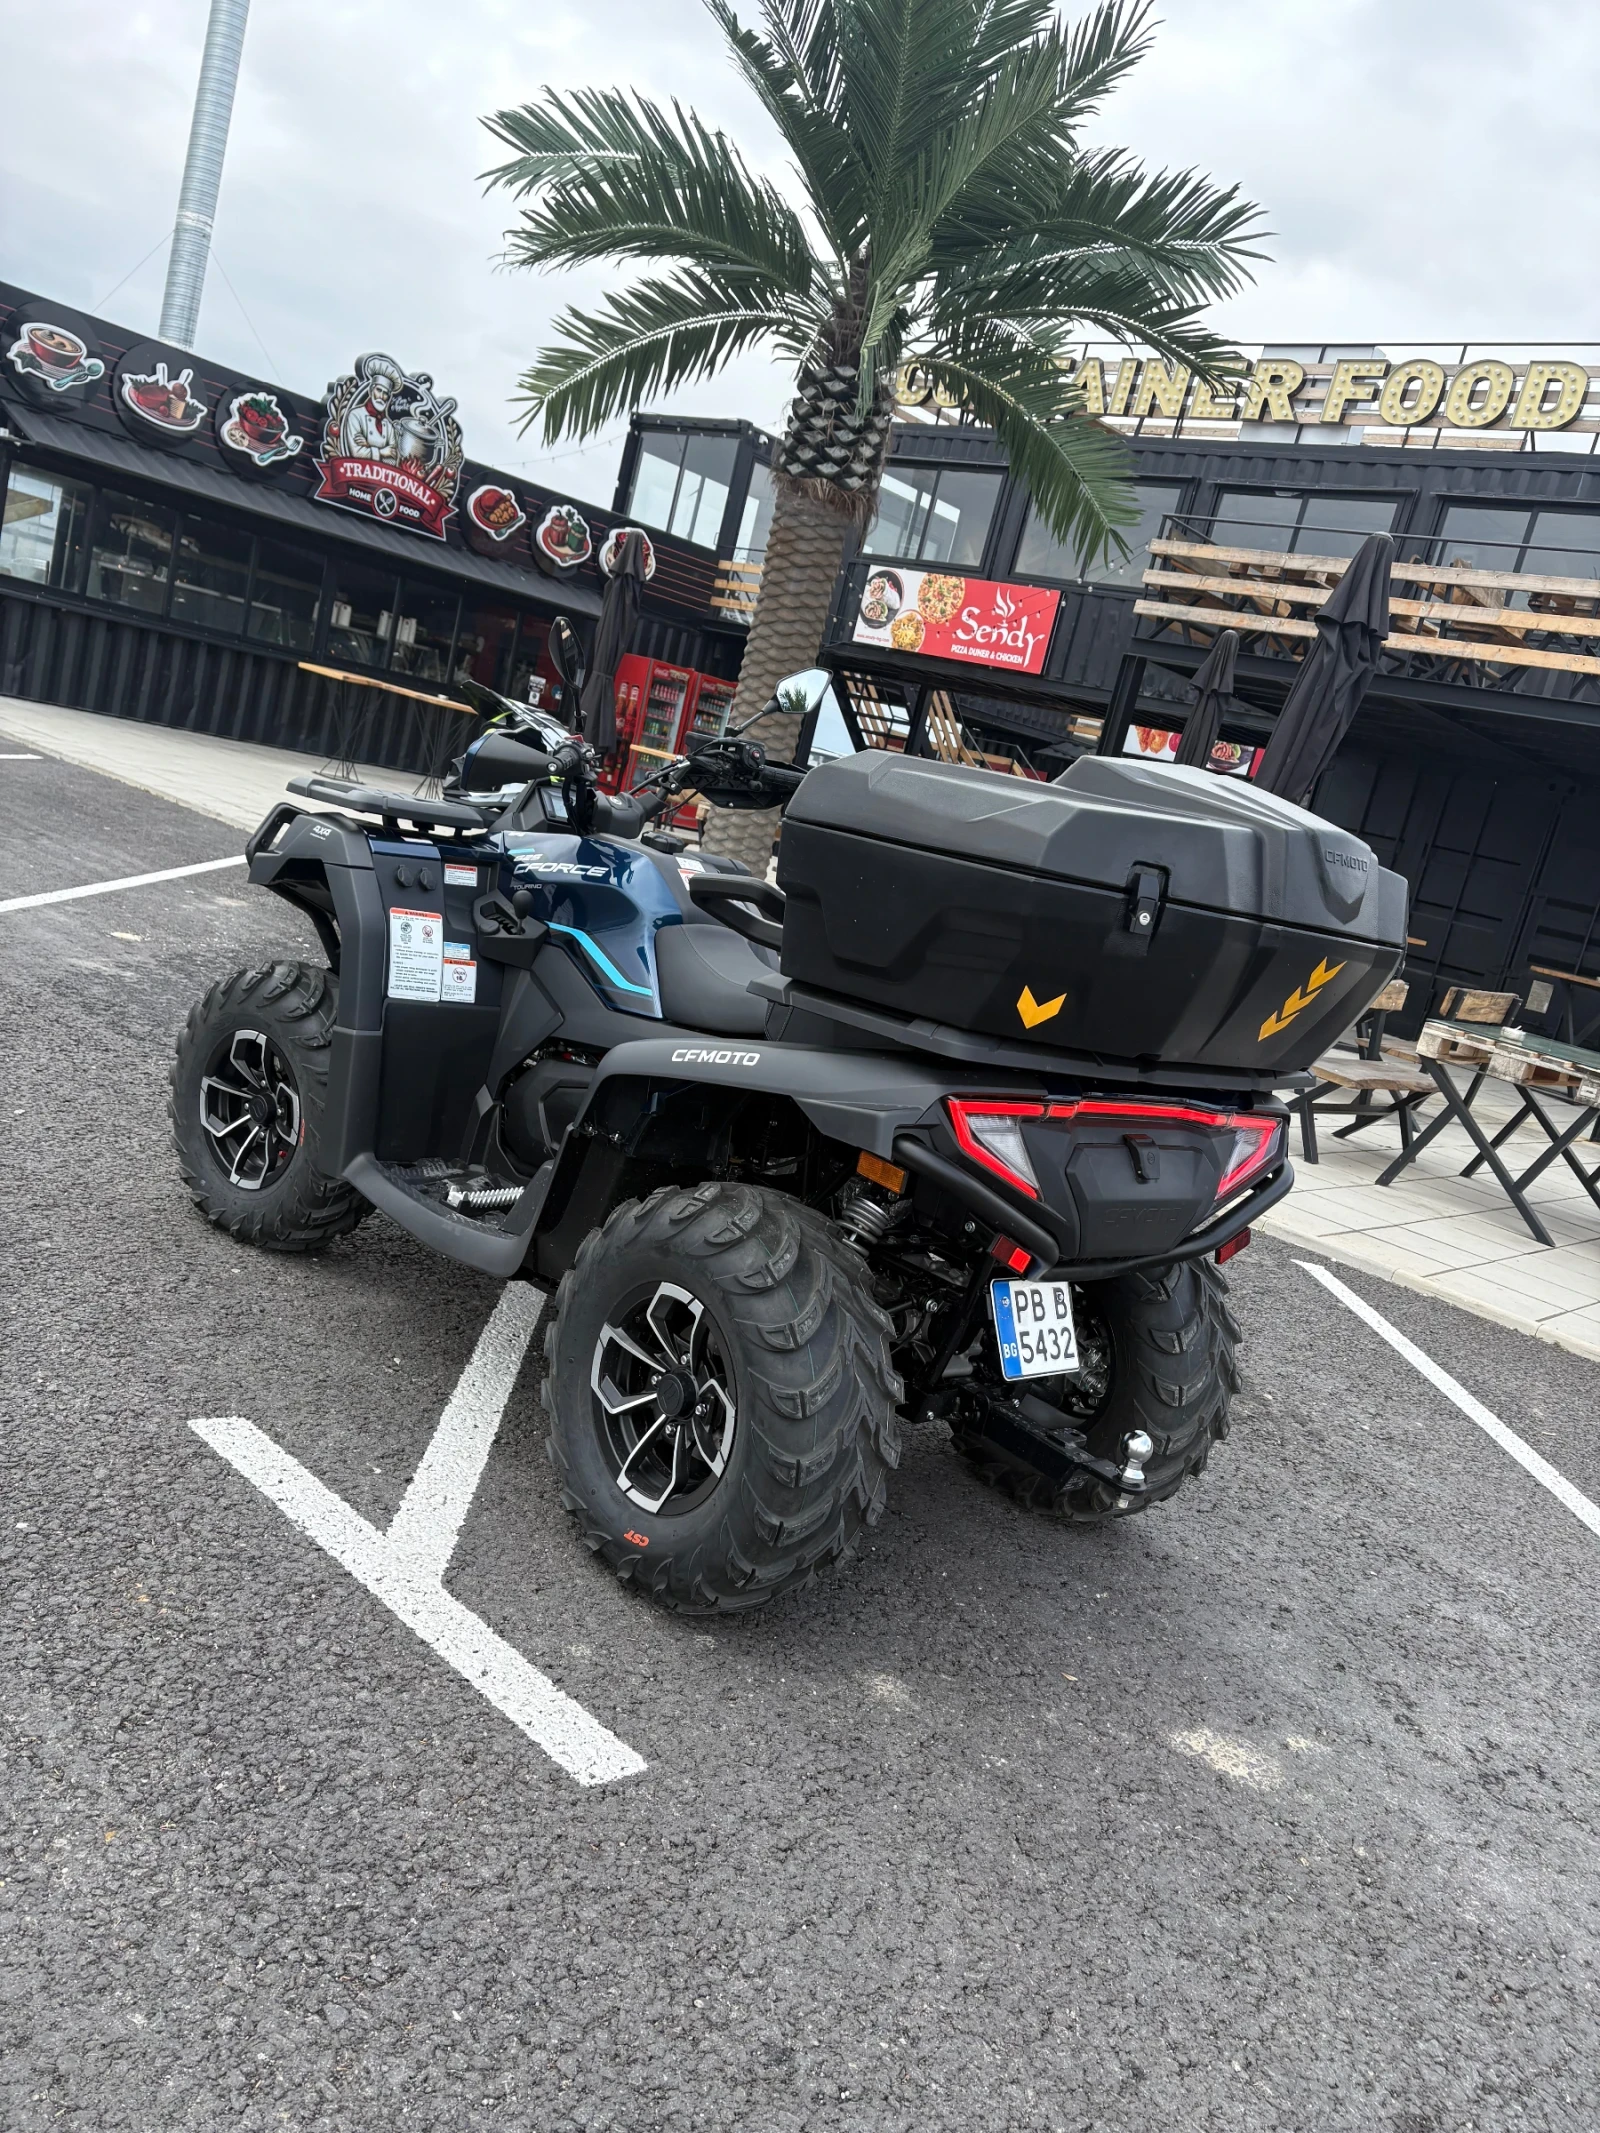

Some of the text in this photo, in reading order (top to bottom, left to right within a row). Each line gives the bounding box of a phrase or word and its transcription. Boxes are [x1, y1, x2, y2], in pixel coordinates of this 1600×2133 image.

[1320, 358, 1591, 430] FOOD
[342, 462, 432, 505] TRADITIONAL
[349, 488, 372, 502] HOME
[399, 506, 420, 518] FOOD
[955, 606, 1045, 668] Sendy
[951, 644, 968, 656] PIZZA
[968, 648, 989, 658] DUNER
[996, 653, 1023, 665] CHICKEN
[513, 862, 609, 877] CFORCE
[1325, 849, 1368, 872] CFMOTO
[513, 883, 542, 891] TOURING
[671, 1049, 761, 1066] CFMOTO
[1014, 1287, 1068, 1324] PB B
[1003, 1342, 1018, 1359] BG
[1019, 1326, 1075, 1364] 5432
[623, 1529, 650, 1547] CST
